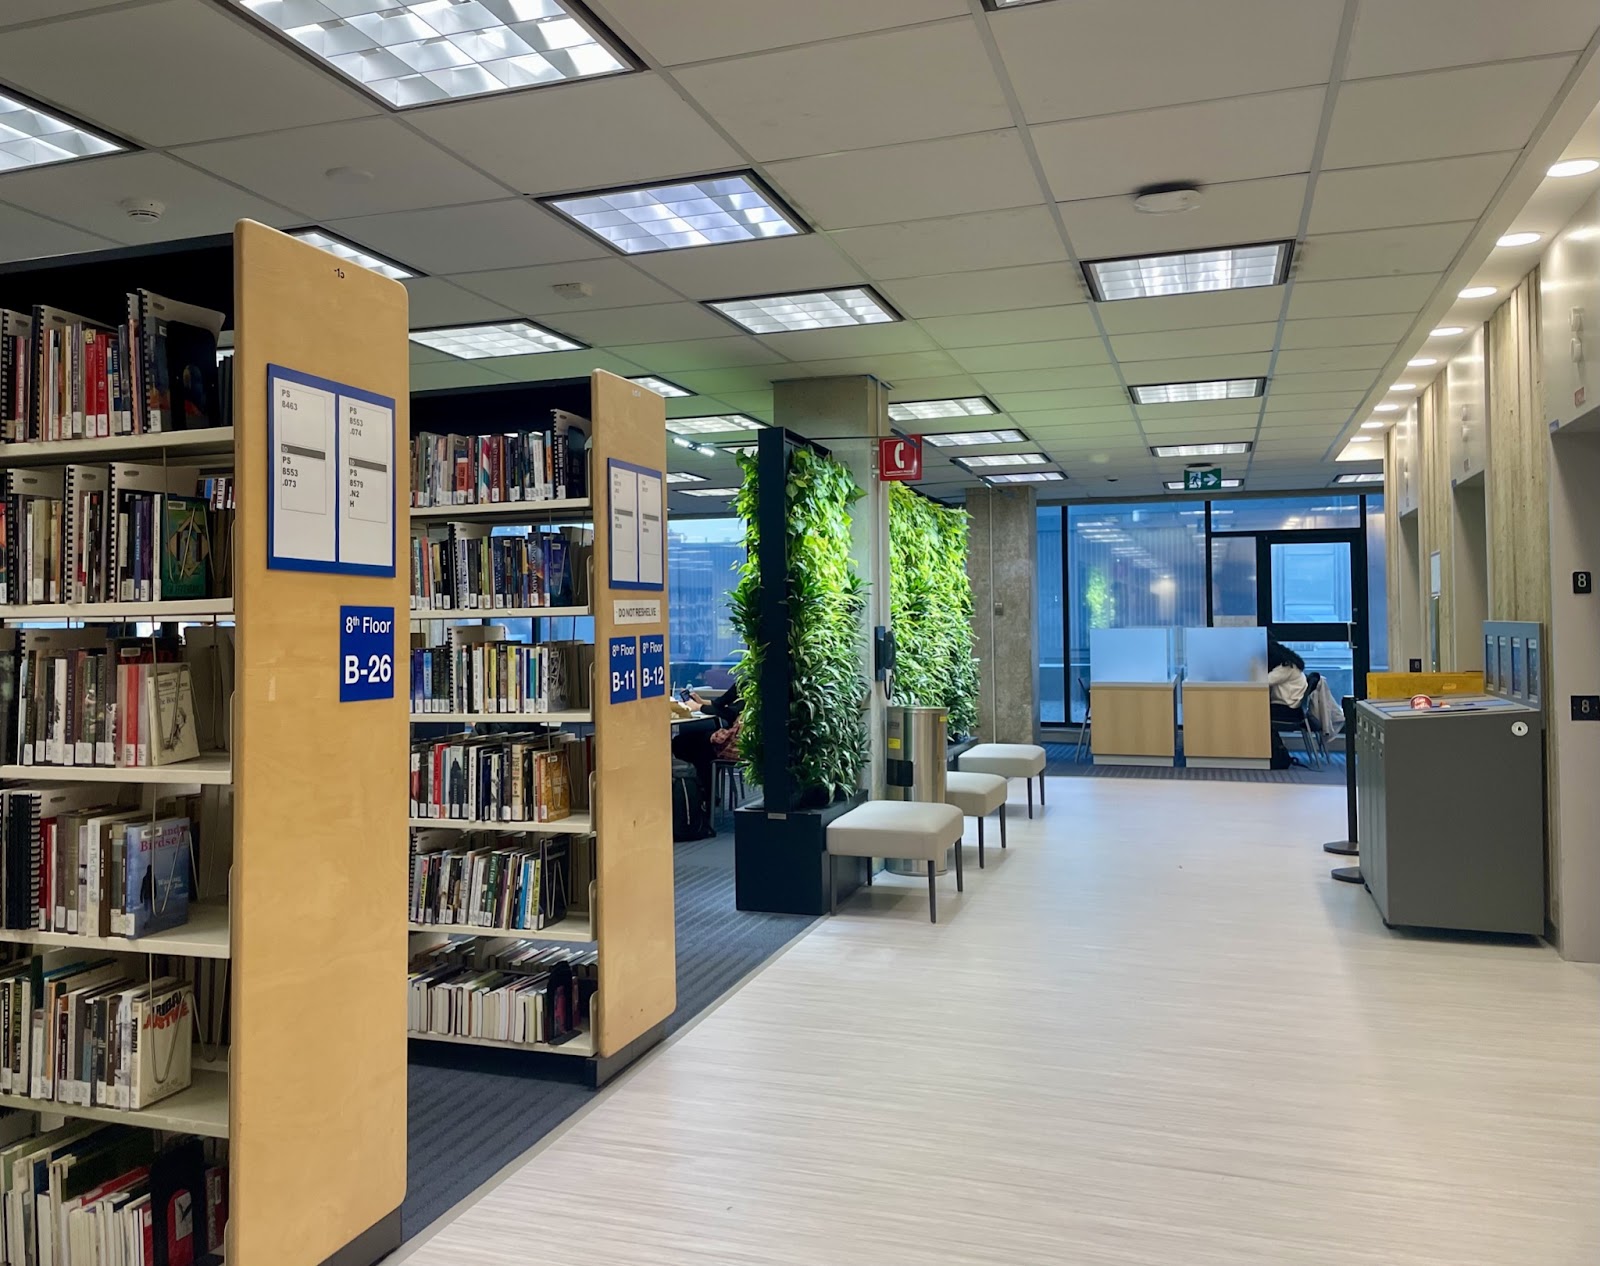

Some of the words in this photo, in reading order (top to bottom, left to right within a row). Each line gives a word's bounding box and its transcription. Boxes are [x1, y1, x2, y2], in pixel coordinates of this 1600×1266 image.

[281, 389, 291, 398] PS
[281, 400, 298, 411] 8463
[349, 406, 357, 415] PS
[349, 417, 364, 427] 8553
[282, 456, 291, 465] PS
[282, 467, 299, 477] 8553
[349, 469, 358, 477] PS
[349, 479, 364, 489] 8579
[349, 490, 360, 498] .N2
[349, 500, 355, 508] H
[1577, 573, 1587, 588] 8
[618, 608, 626, 618] DO
[626, 608, 635, 618] NOT
[635, 607, 657, 617] RESHELVE
[345, 615, 360, 634] 8th
[363, 616, 392, 634] Floor
[620, 643, 635, 657] Floor
[649, 641, 663, 653] Floor
[344, 654, 392, 685] B-26
[612, 669, 635, 692] B-11
[642, 665, 665, 687] B-12
[1580, 699, 1590, 713] 8
[14, 984, 22, 1012] ARTHUR
[14, 1014, 22, 1037] BLACK
